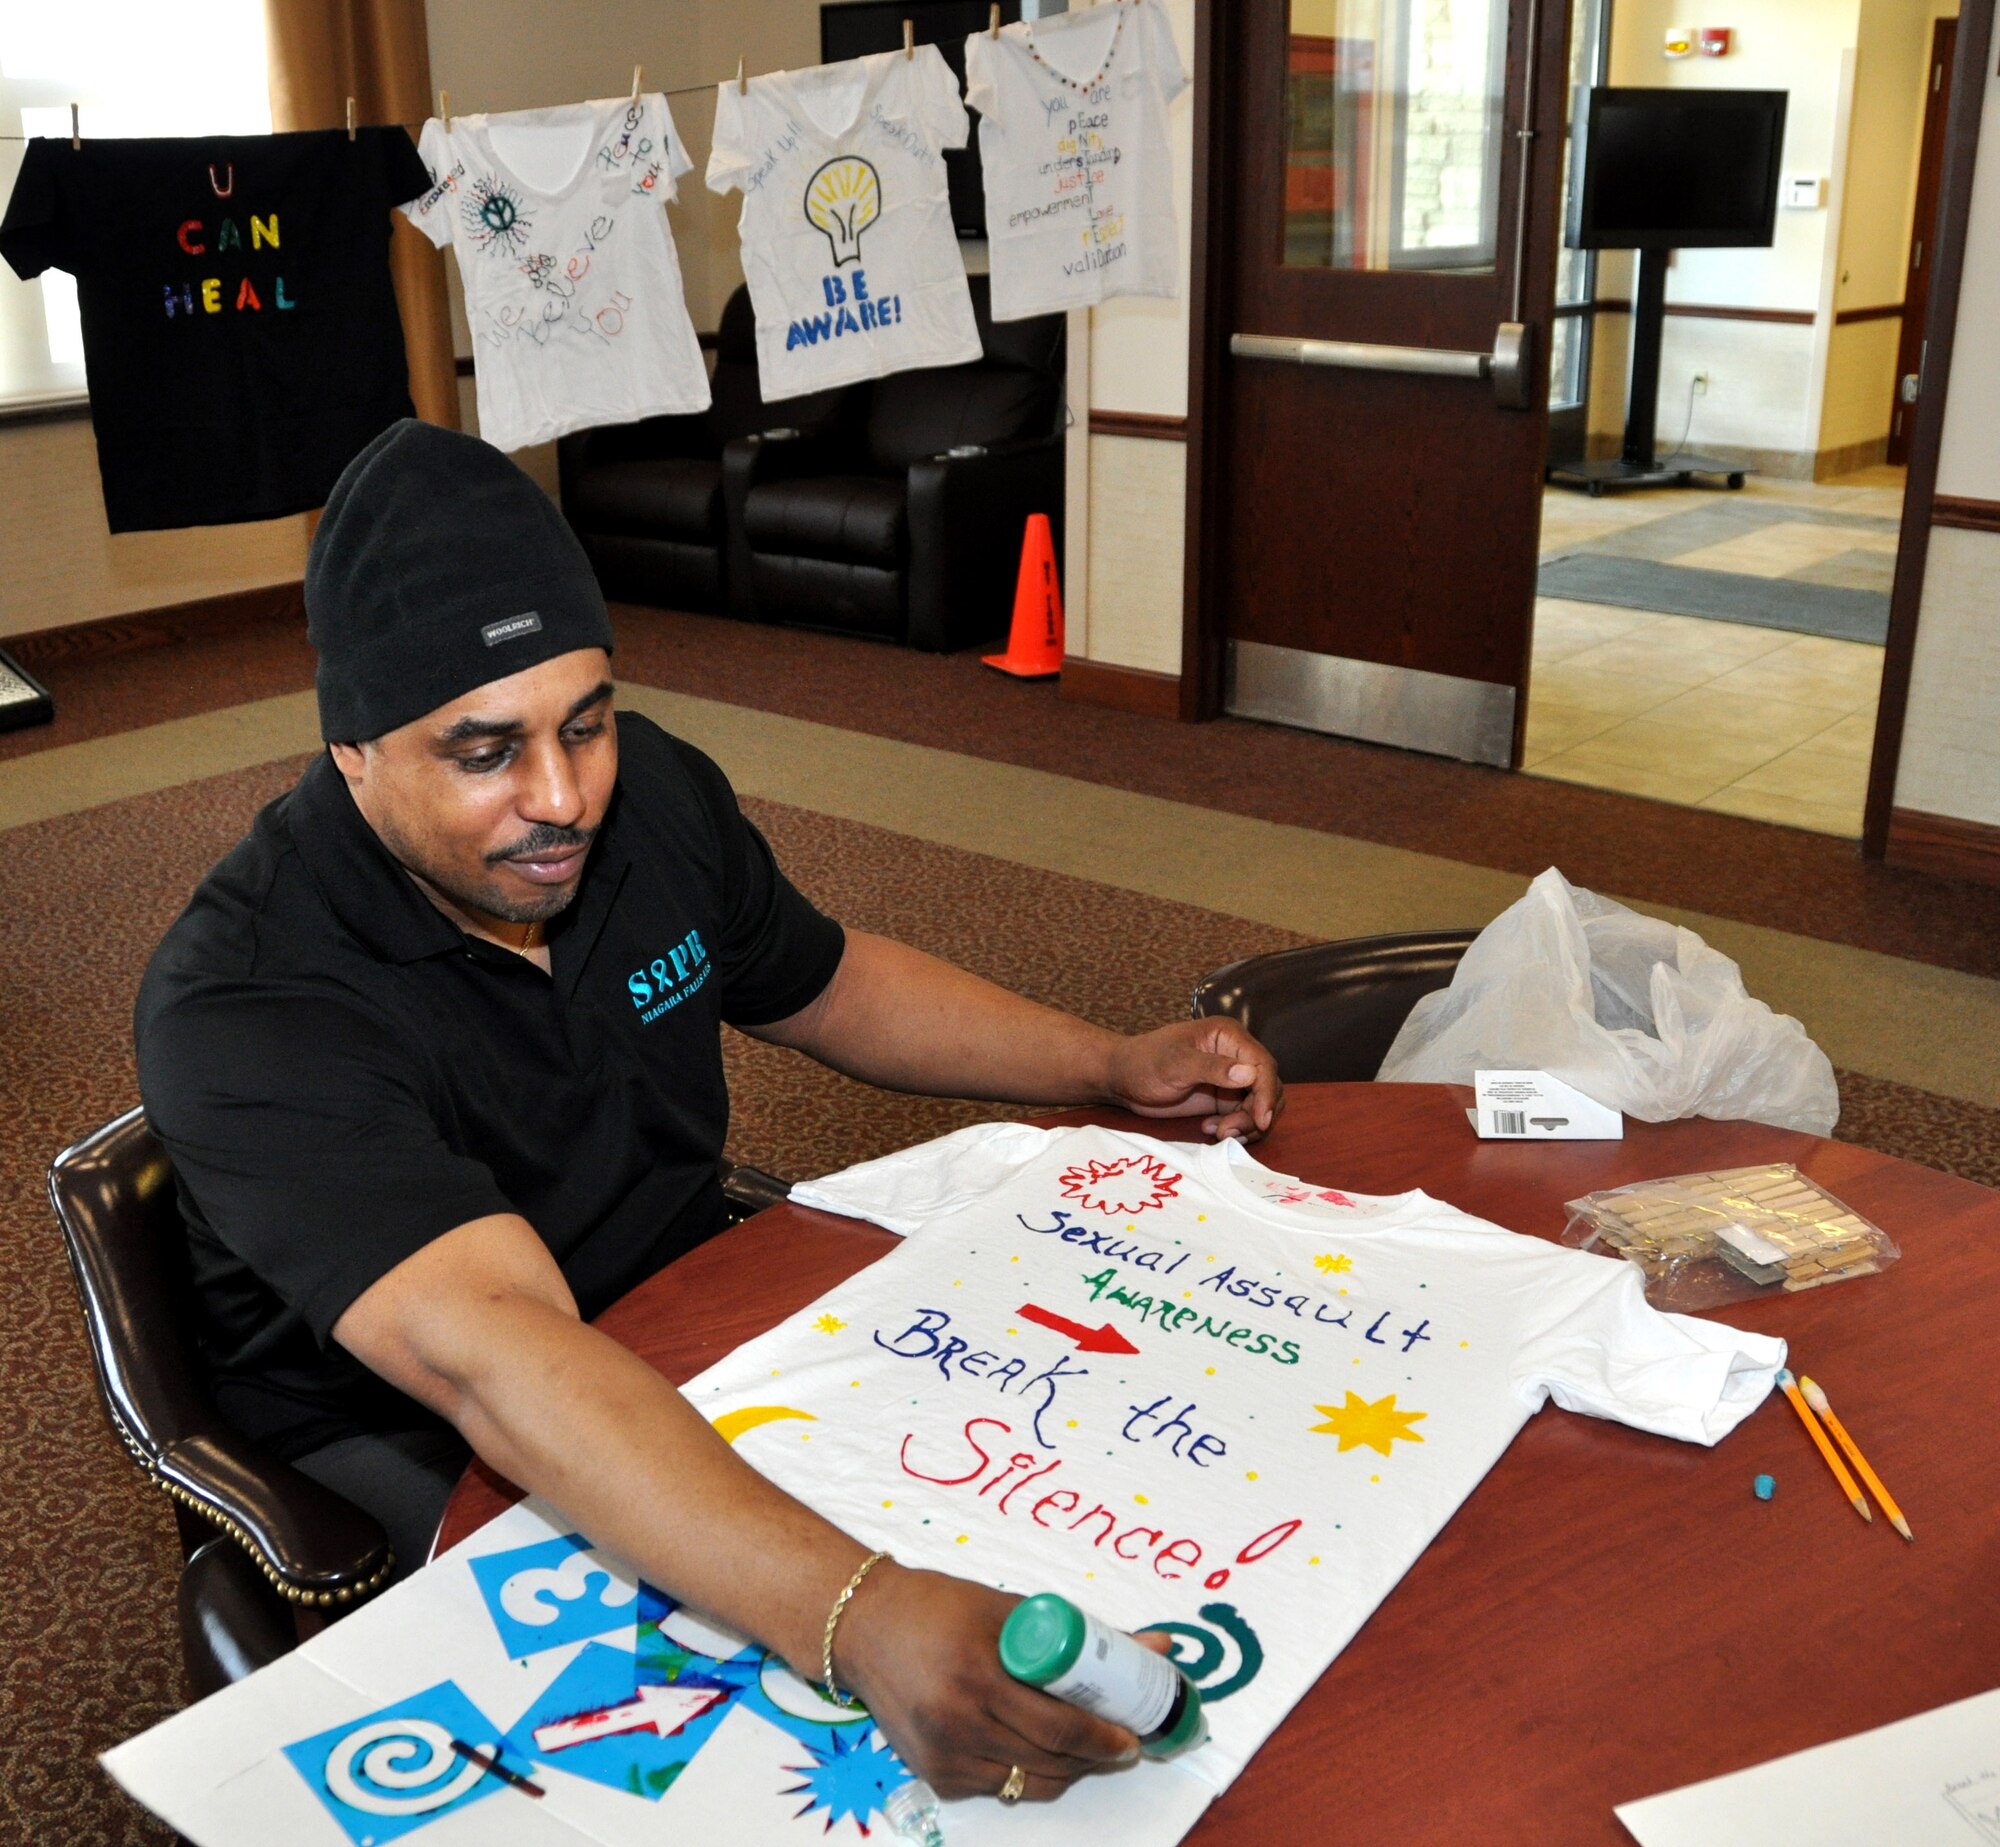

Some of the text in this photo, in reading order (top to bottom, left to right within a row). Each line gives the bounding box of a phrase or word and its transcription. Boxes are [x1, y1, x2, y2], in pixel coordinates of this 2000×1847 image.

[1041, 84, 1112, 129] you are
[208, 163, 234, 198] U
[177, 214, 281, 255] CAN
[163, 276, 296, 319] HEAL
[822, 269, 869, 307] BE
[786, 295, 902, 350] AWARE!
[640, 992, 683, 1025] NIAGARA
[1121, 1395, 1228, 1468] the
